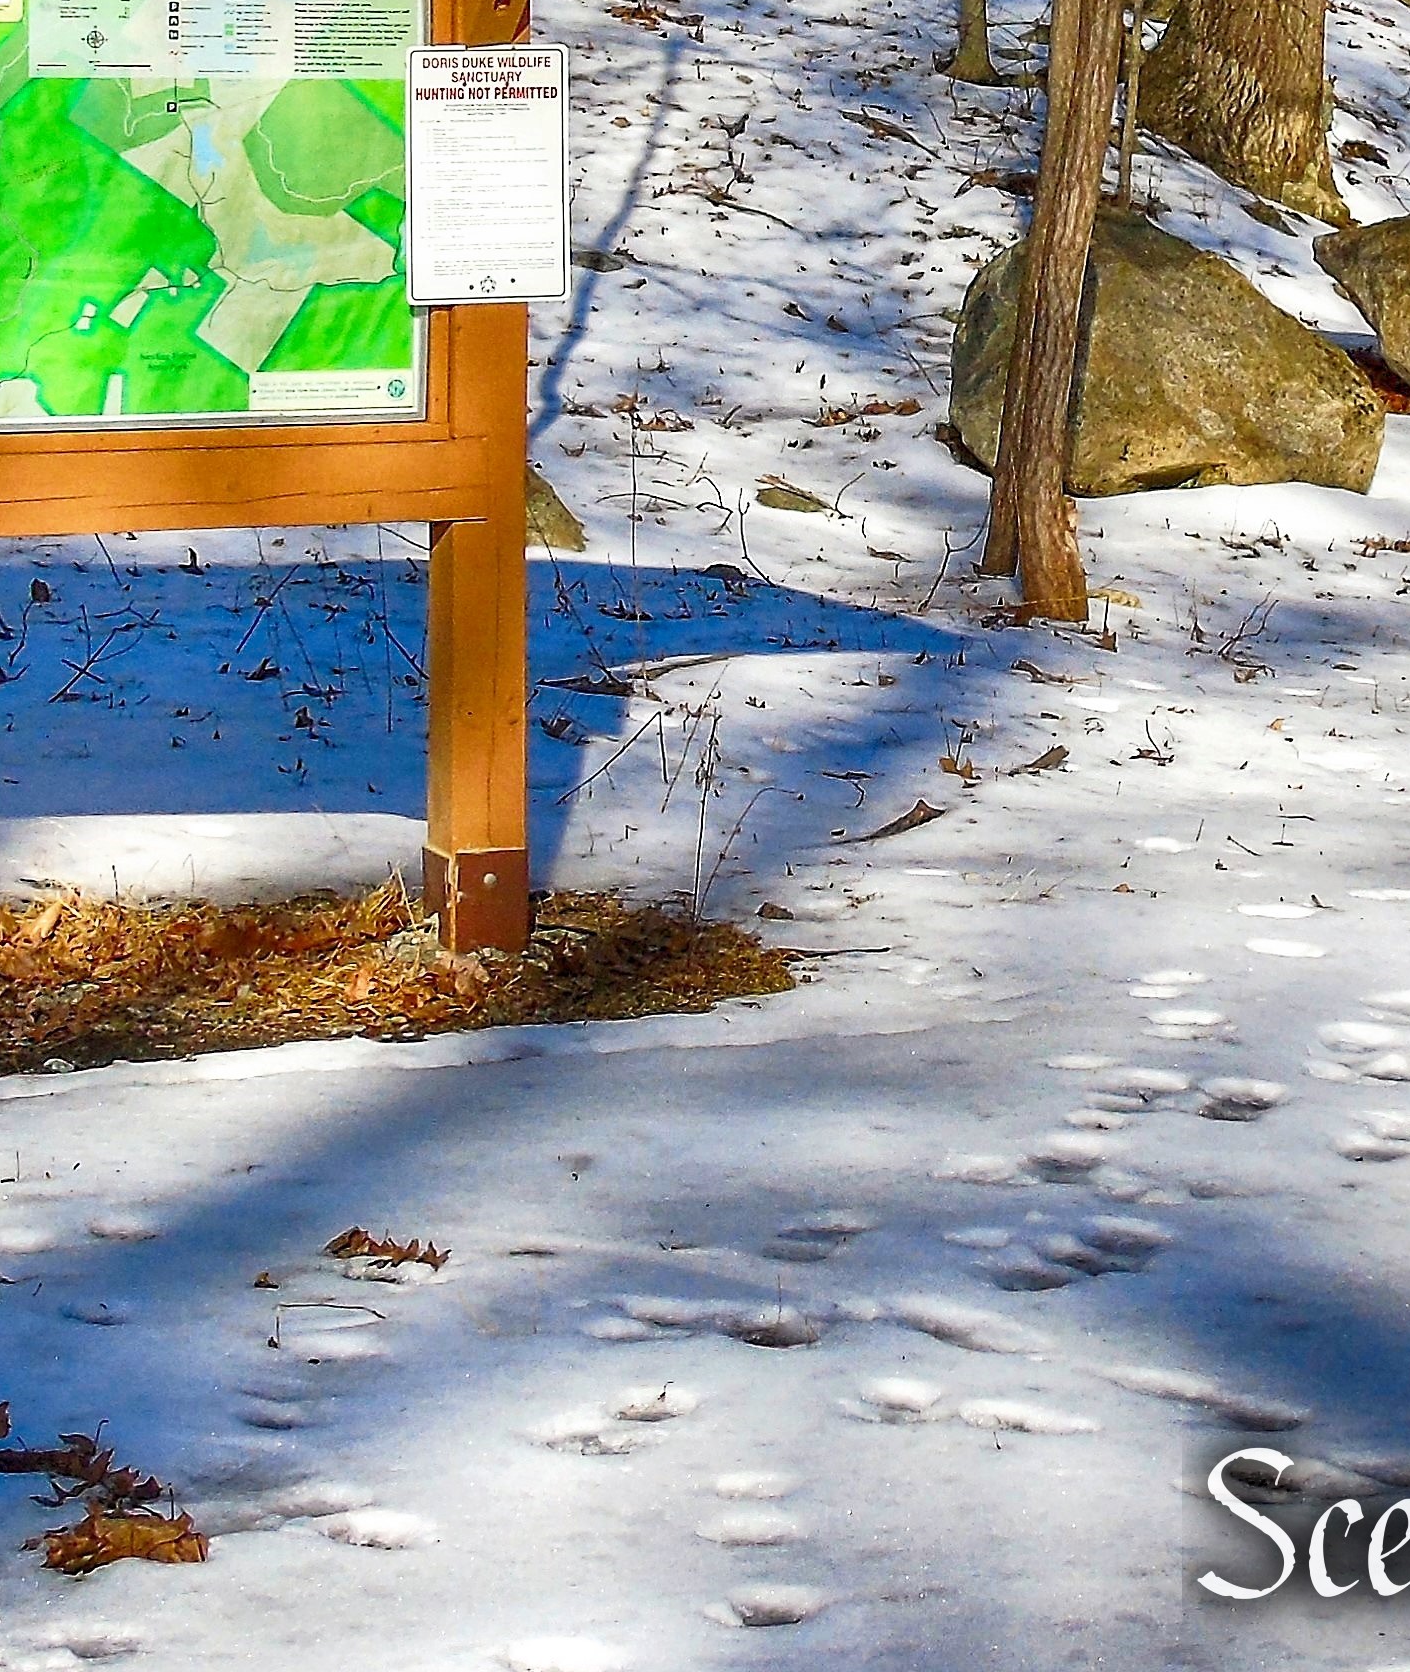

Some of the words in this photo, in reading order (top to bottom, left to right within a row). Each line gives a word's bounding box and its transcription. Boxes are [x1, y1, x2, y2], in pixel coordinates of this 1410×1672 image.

[422, 57, 459, 69] DORIS
[462, 57, 494, 68] DUKE
[497, 56, 551, 68] WILDLIFE
[451, 71, 522, 83] SANCTUARY
[415, 87, 465, 101] HUNTING
[468, 87, 491, 100] NOT
[494, 86, 558, 100] PERMITTED
